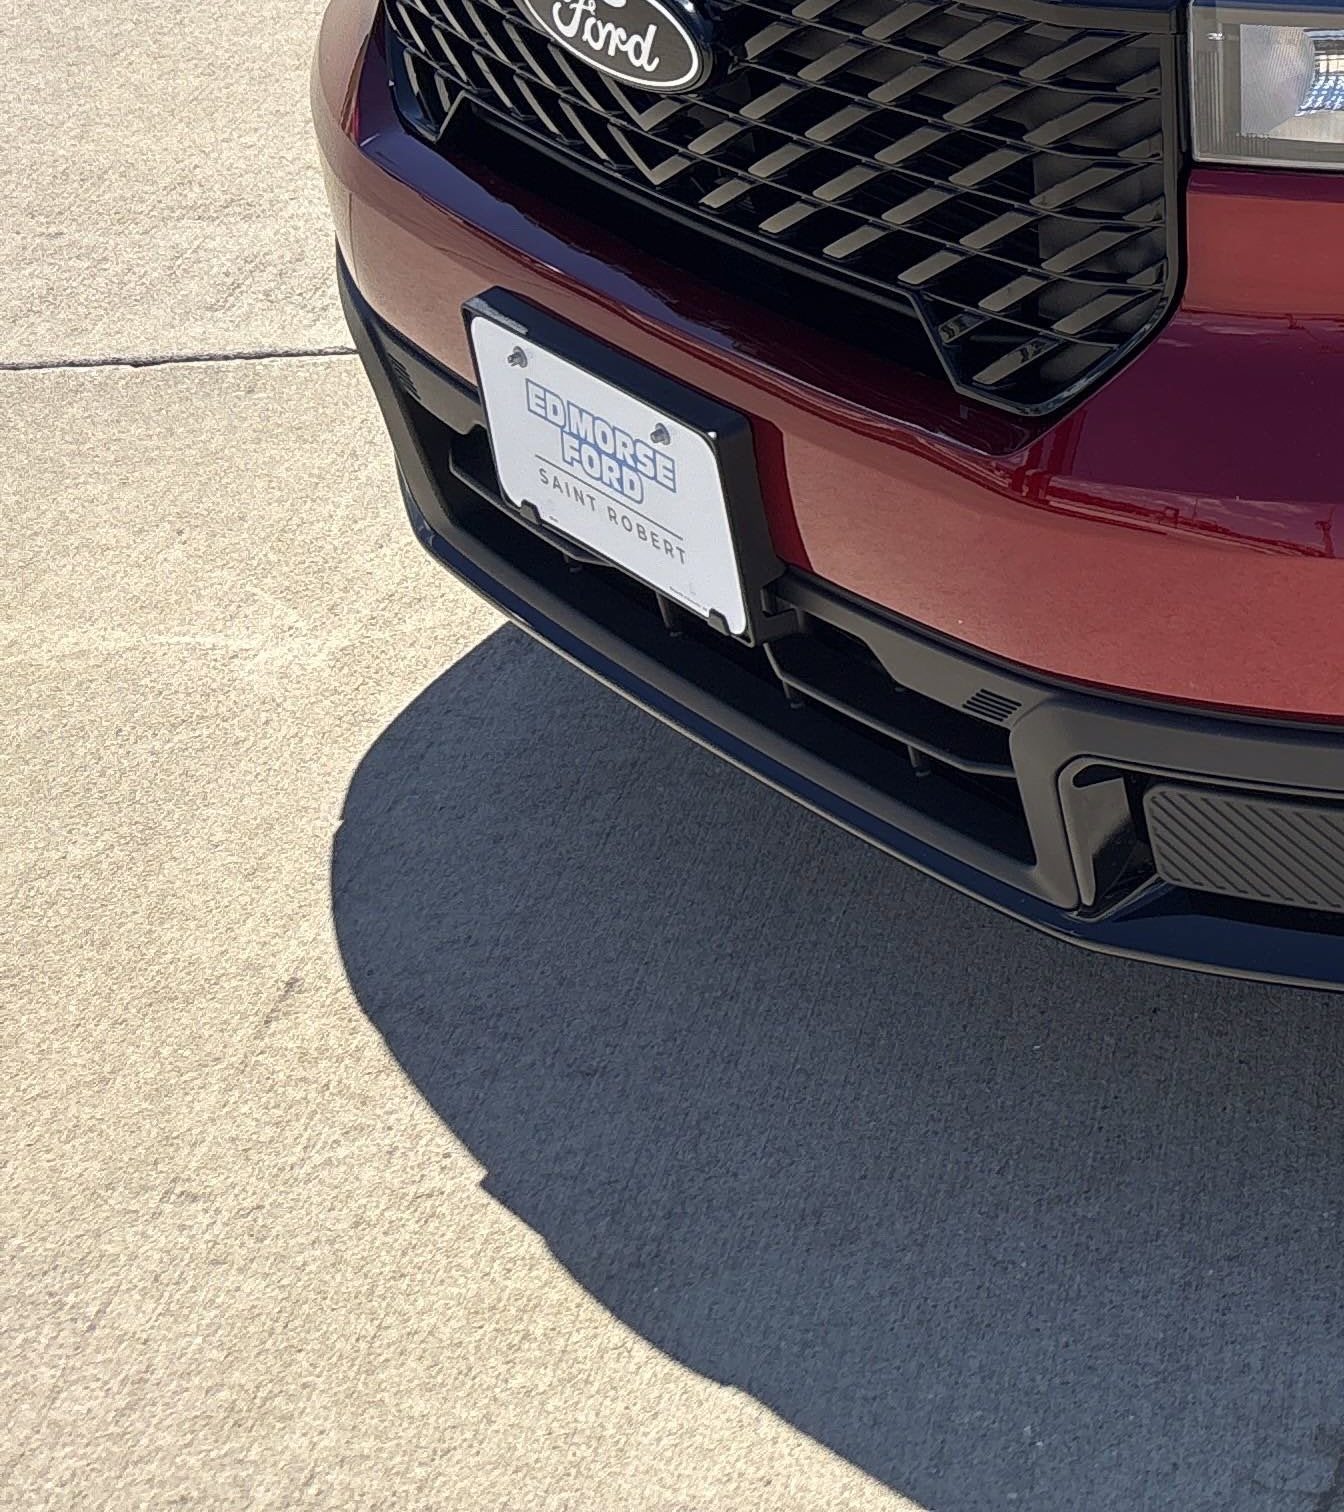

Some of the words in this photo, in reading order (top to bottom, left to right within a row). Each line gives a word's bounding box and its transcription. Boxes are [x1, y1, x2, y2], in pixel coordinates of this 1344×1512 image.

[525, 378, 566, 427] ED
[566, 401, 677, 493] MORSE
[560, 427, 645, 505] FORD
[537, 467, 597, 512] SAINT
[606, 505, 686, 565] ROBERT
